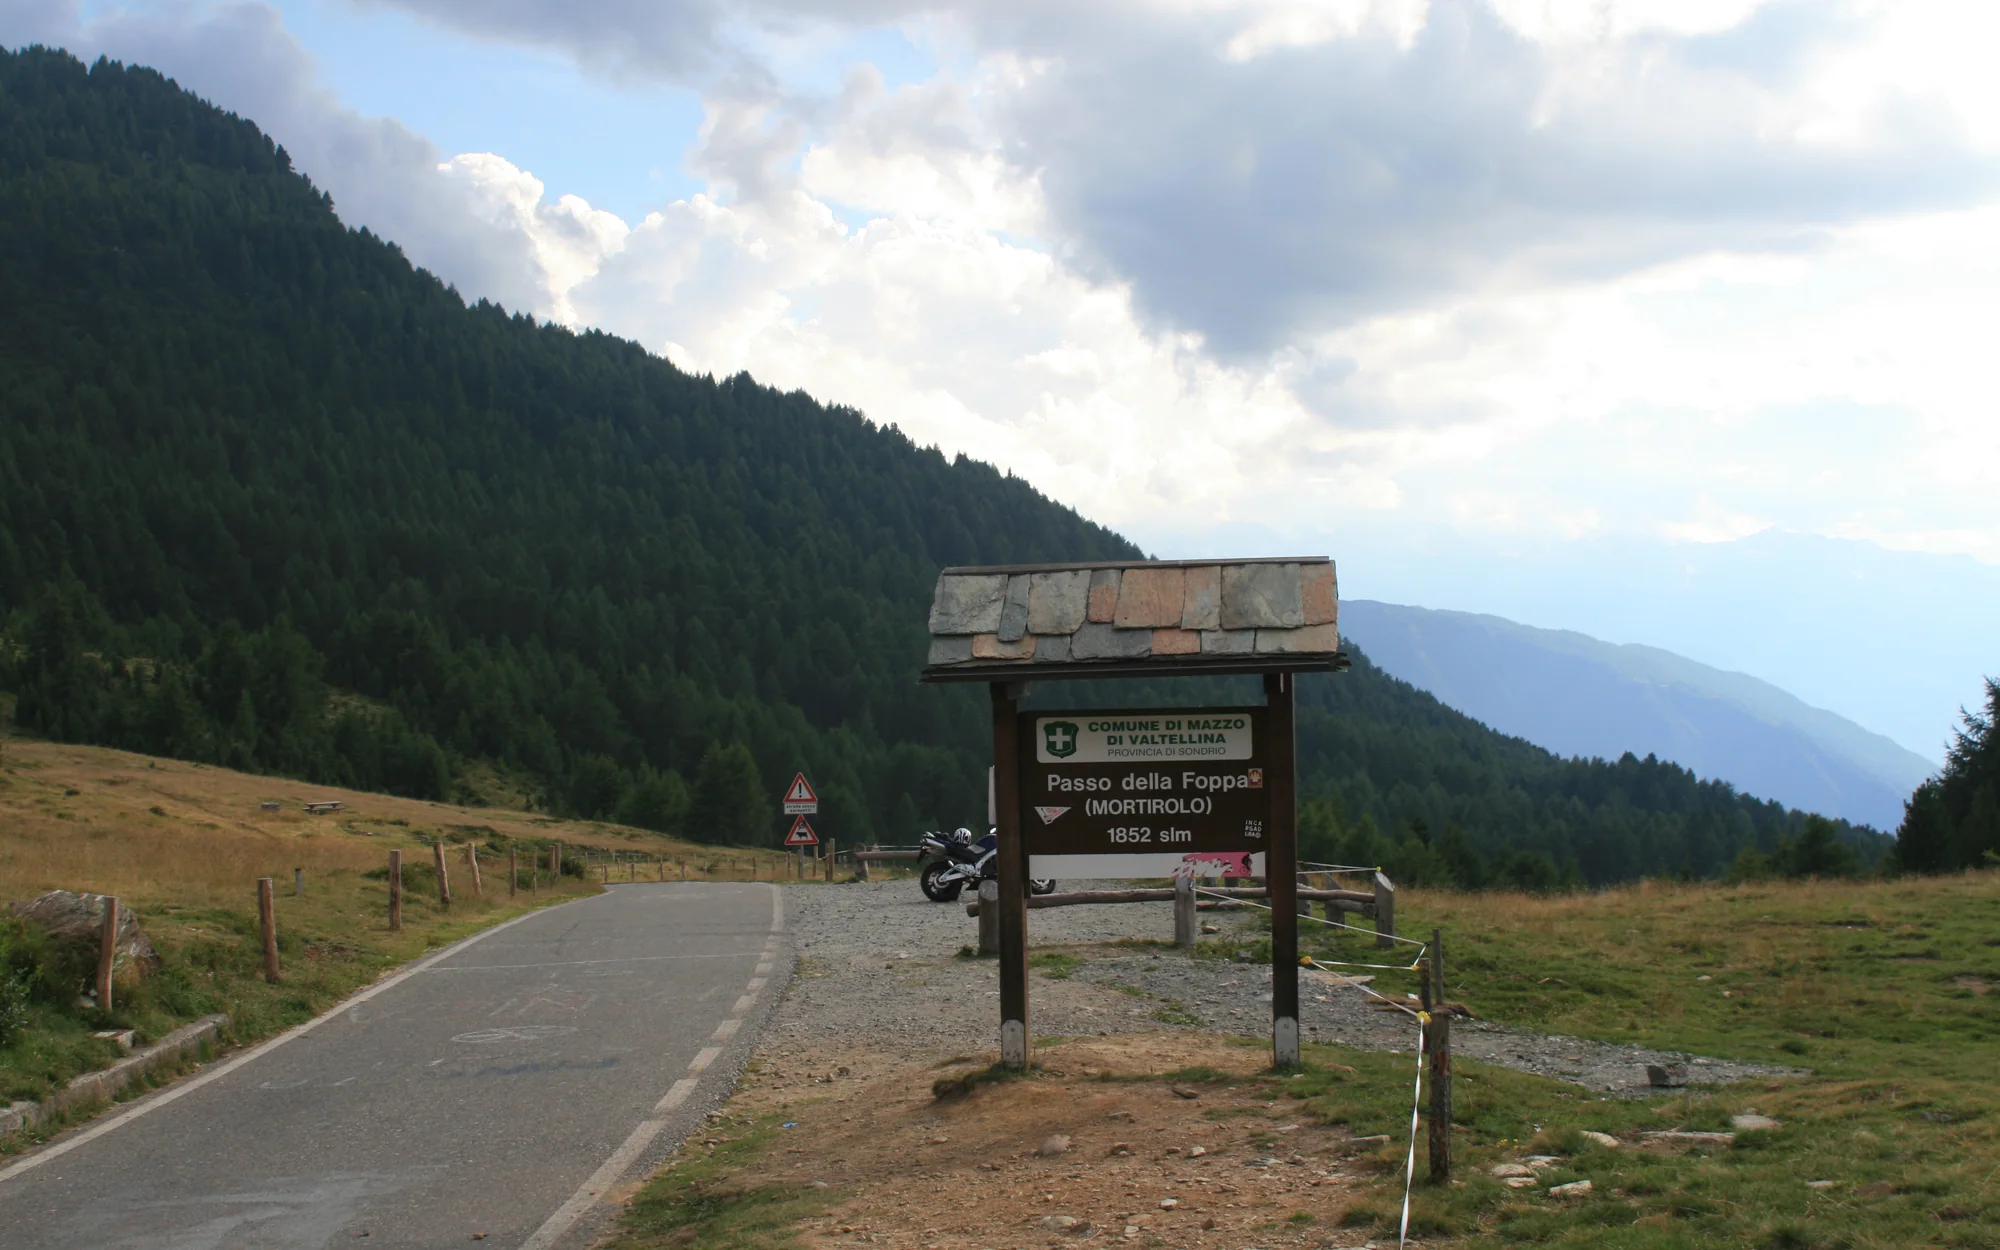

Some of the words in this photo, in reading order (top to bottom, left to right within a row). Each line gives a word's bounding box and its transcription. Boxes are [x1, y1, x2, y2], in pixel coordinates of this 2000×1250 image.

[1088, 720, 1160, 732] COMUNE
[1165, 720, 1182, 730] DI
[1187, 718, 1245, 730] MAZZO
[1107, 736, 1123, 746] DI
[1129, 733, 1226, 745] VALTELLINA
[1107, 748, 1162, 757] PROVINCIA
[1165, 748, 1175, 756] DI
[1178, 747, 1226, 756] SONDRIO
[1047, 774, 1111, 791] Passo
[1121, 772, 1172, 790] della
[1182, 771, 1248, 792] Foppa
[1085, 796, 1212, 817] (MORTIROLO)
[1107, 827, 1151, 843] 1852
[1159, 827, 1192, 842] slm
